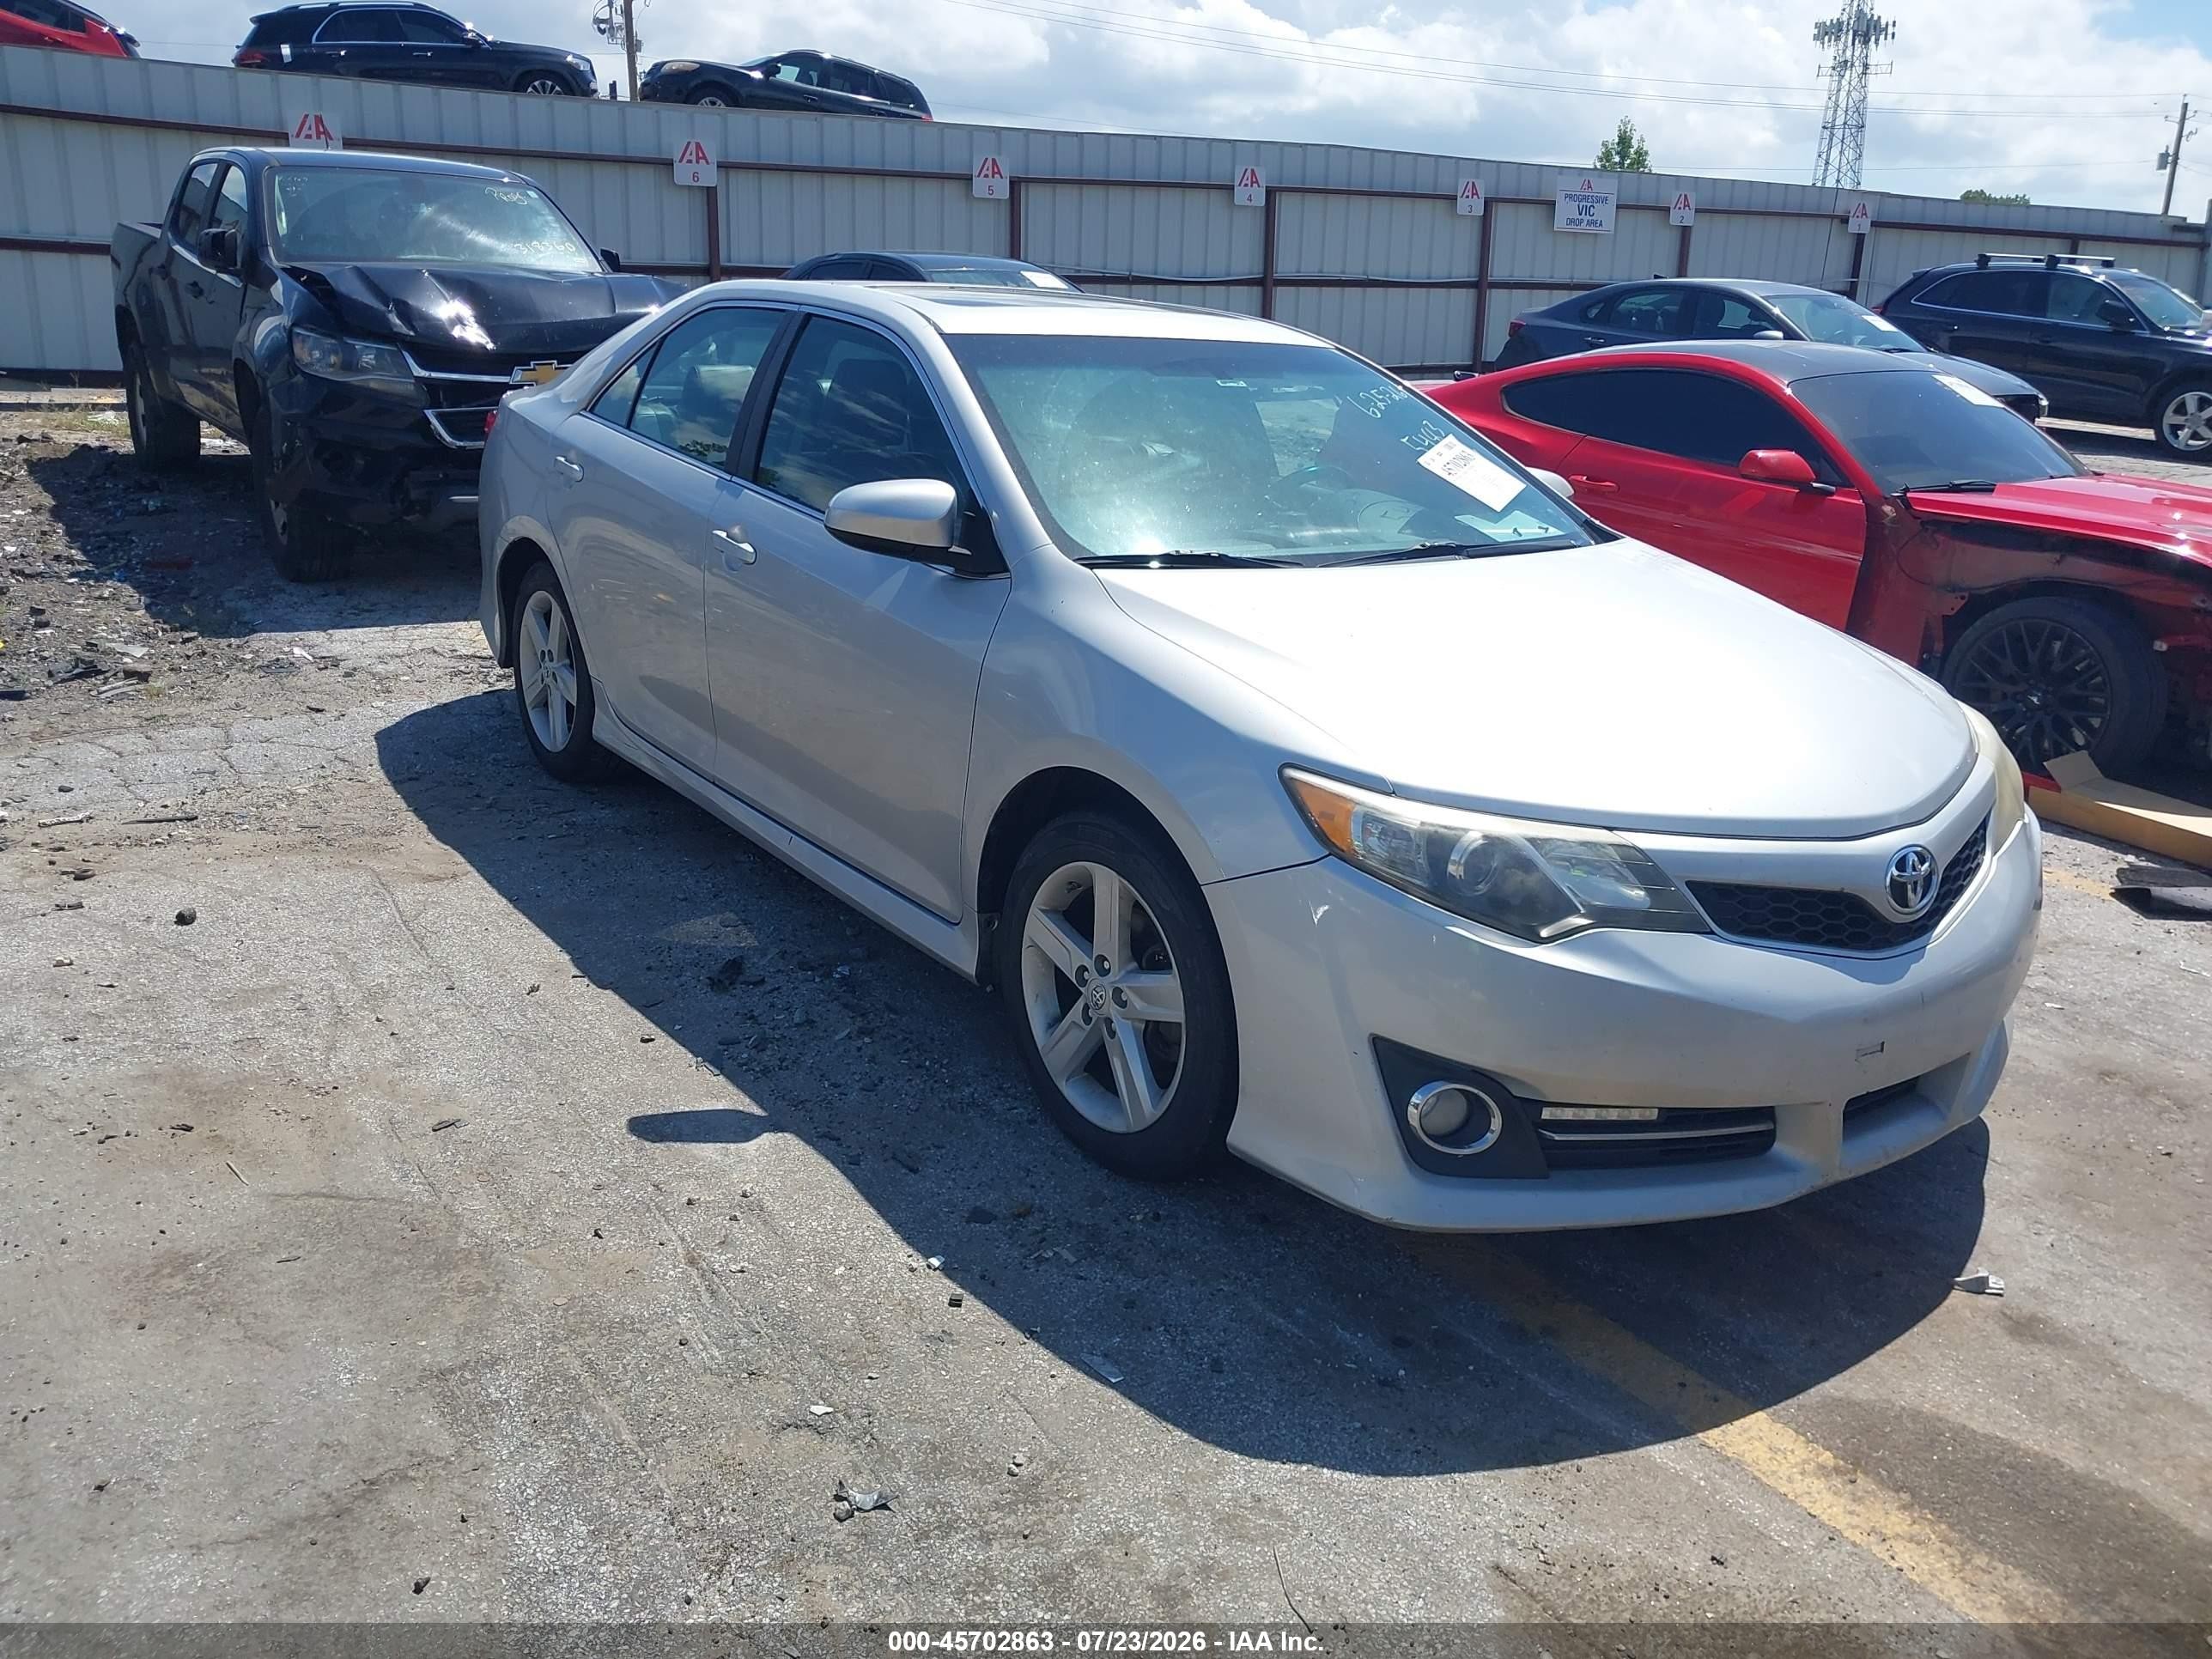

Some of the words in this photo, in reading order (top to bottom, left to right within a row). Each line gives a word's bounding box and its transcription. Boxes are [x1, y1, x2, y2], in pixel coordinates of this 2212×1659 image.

[692, 171, 700, 183] 6
[988, 185, 994, 196] 5
[1246, 193, 1253, 204] 4
[1564, 193, 1609, 204] PROGRESSIVE
[1468, 204, 1473, 214] 3
[1577, 204, 1595, 217] VIC
[1565, 217, 1584, 227] DROP
[1679, 216, 1685, 224] 2
